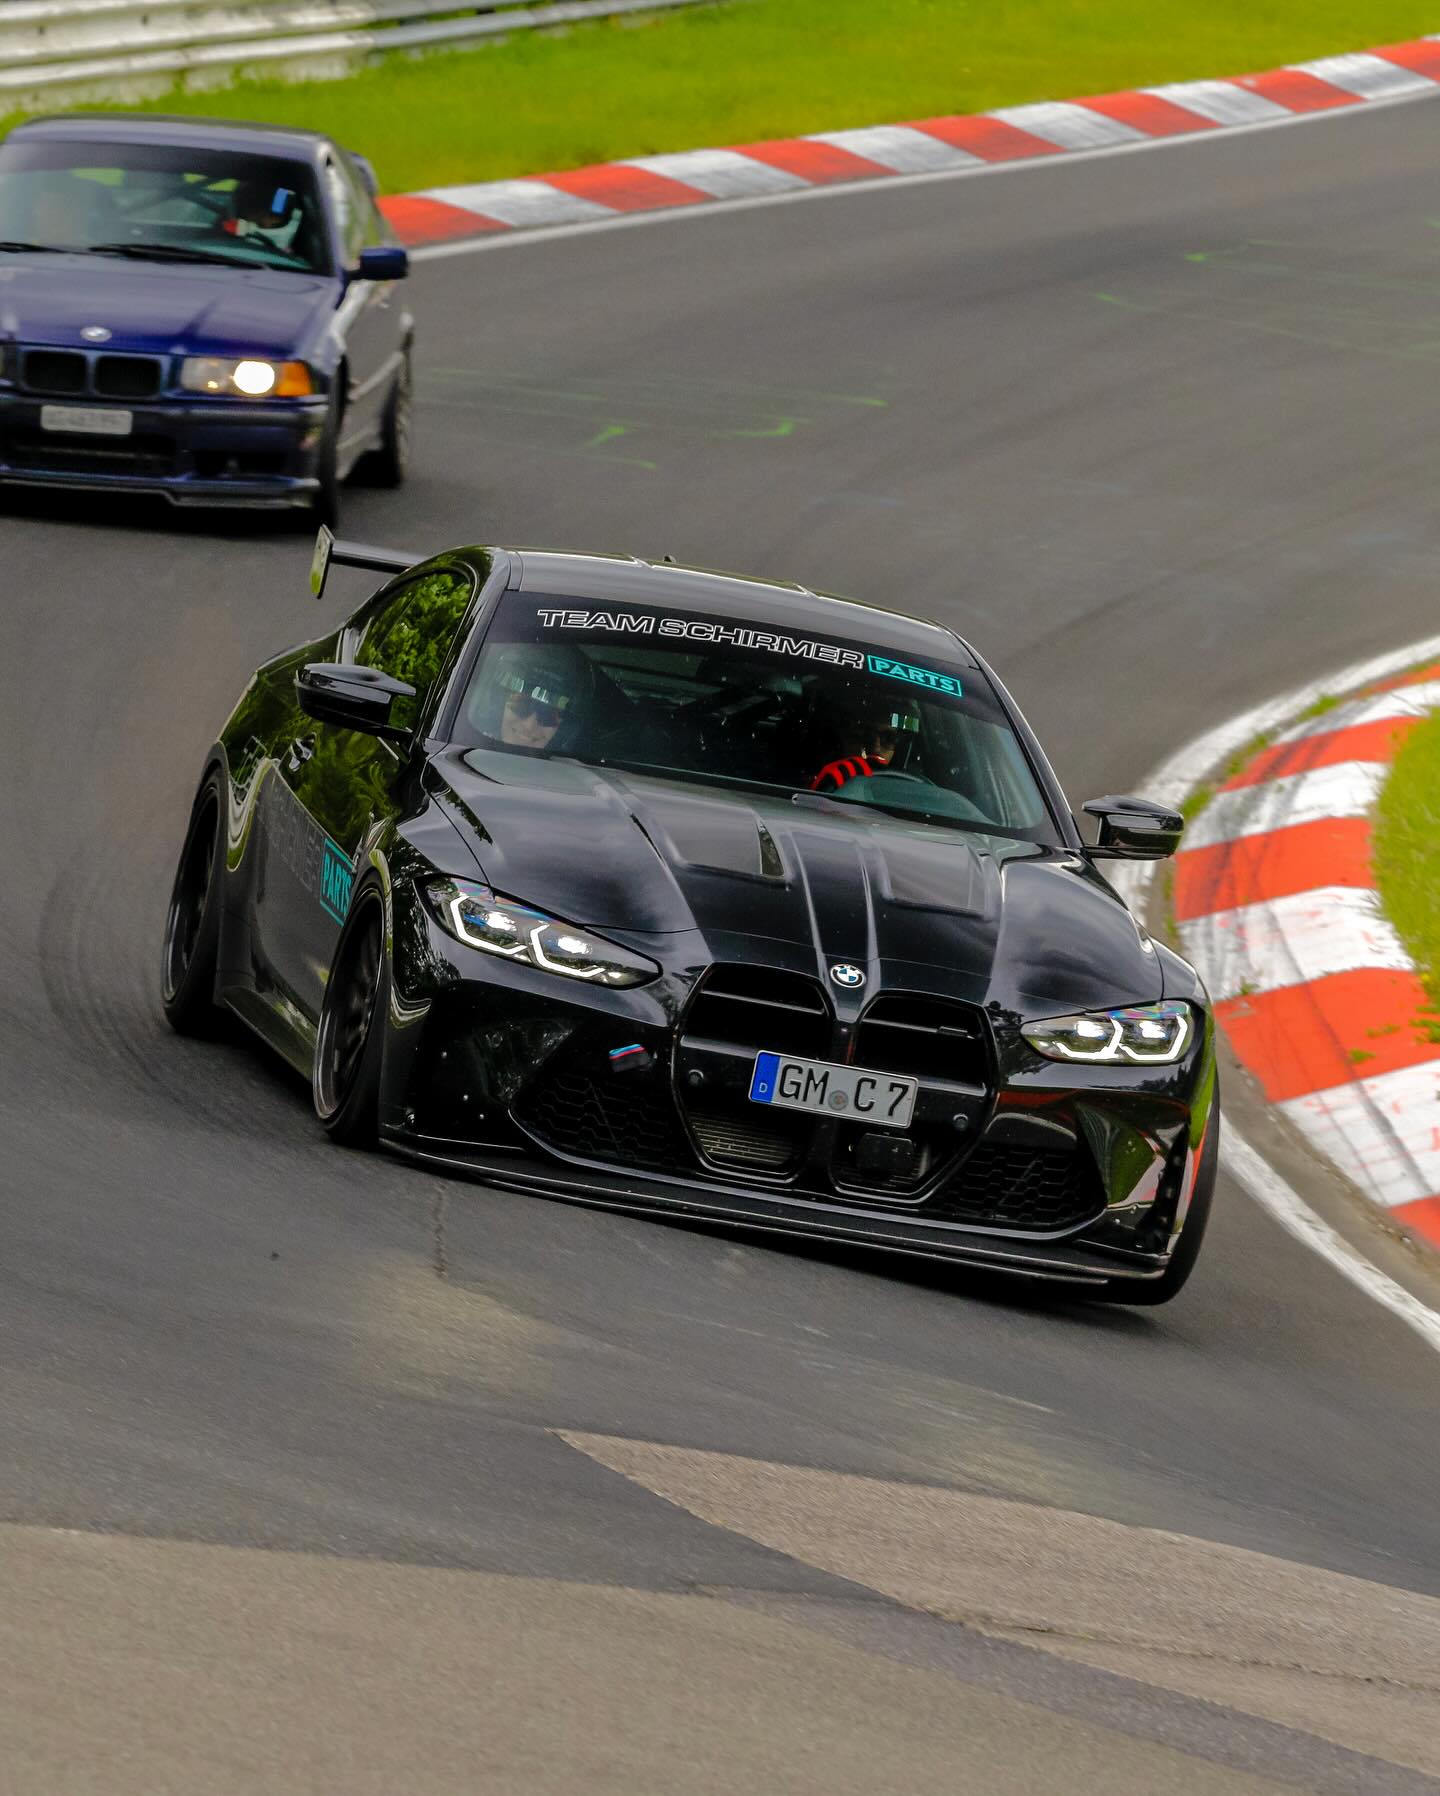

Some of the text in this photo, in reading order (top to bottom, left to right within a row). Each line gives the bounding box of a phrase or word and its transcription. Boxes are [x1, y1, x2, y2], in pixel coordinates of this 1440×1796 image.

[537, 609, 956, 693] TEAM SCHIRMER PARTS
[759, 1082, 768, 1093] D
[779, 1064, 910, 1117] GM C 7
